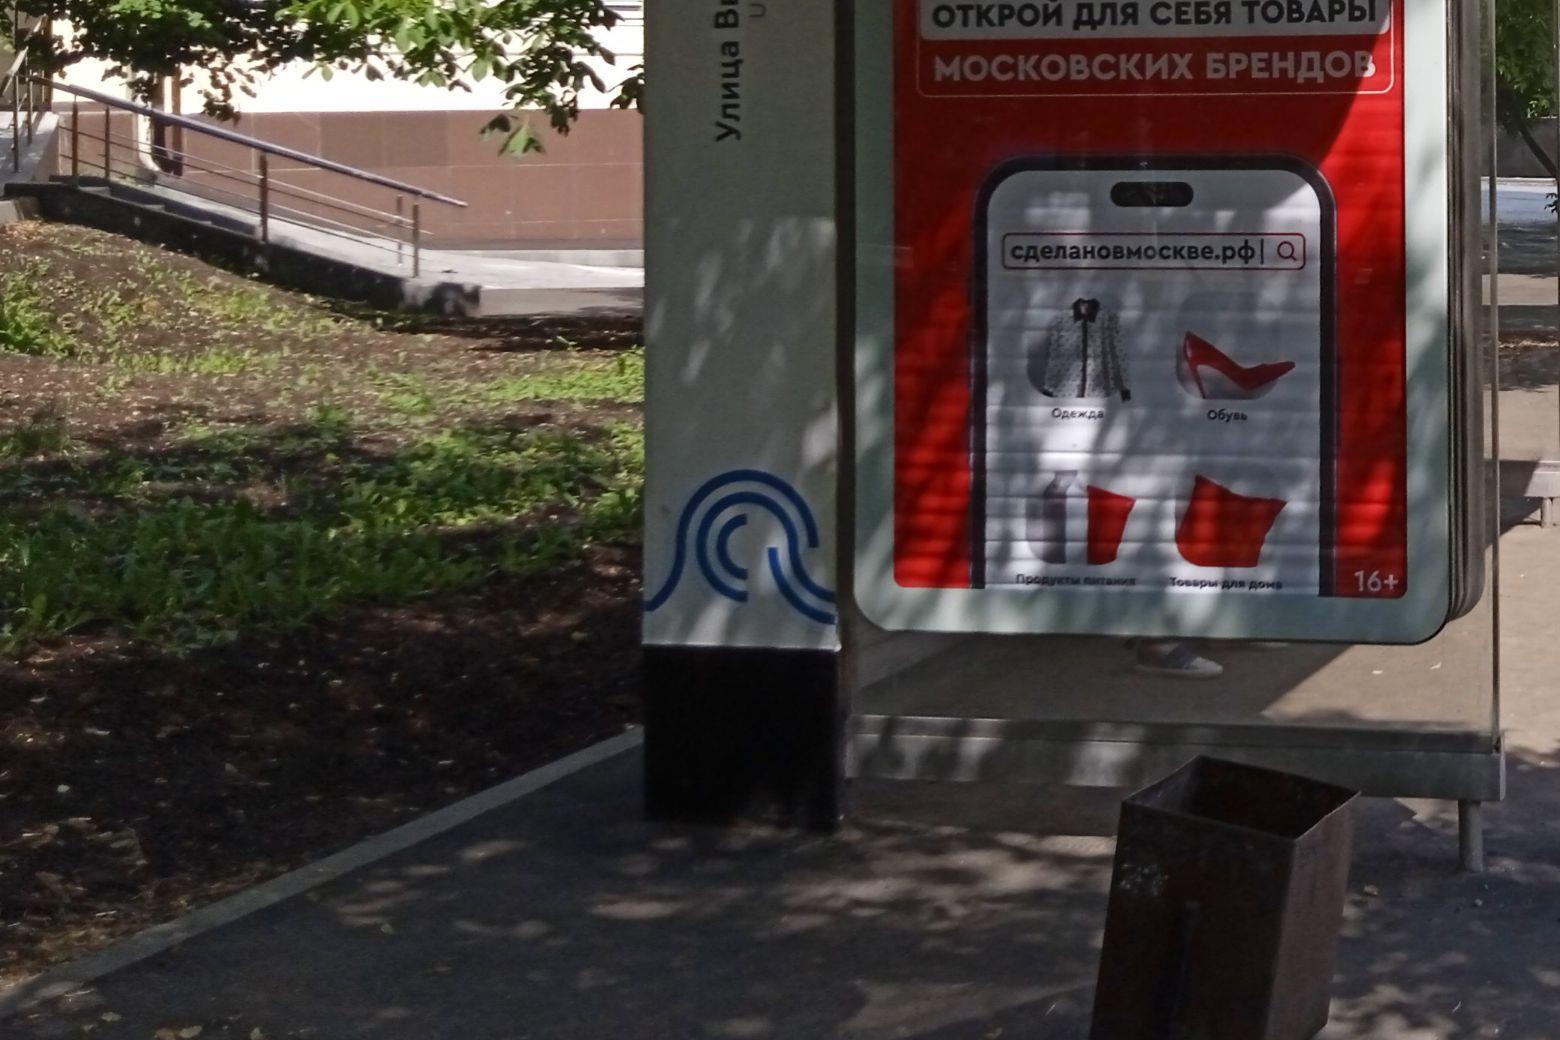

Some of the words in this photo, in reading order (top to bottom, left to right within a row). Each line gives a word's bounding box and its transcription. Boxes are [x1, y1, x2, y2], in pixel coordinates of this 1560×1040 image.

[1072, 1, 1140, 31] ДЛЯ
[1150, 1, 1231, 26] СЕБЯ
[934, 52, 1194, 82] МОСКОВСКИХ
[1206, 50, 1377, 84] БРЕНДОВ
[714, 40, 743, 142] Улица
[1011, 239, 1256, 264] сделановмоскве.рф
[1051, 408, 1105, 420] Одежда
[1206, 408, 1249, 423] Обувь
[1168, 576, 1219, 589] Товары
[1221, 579, 1246, 590] для
[1353, 570, 1399, 591] 16+
